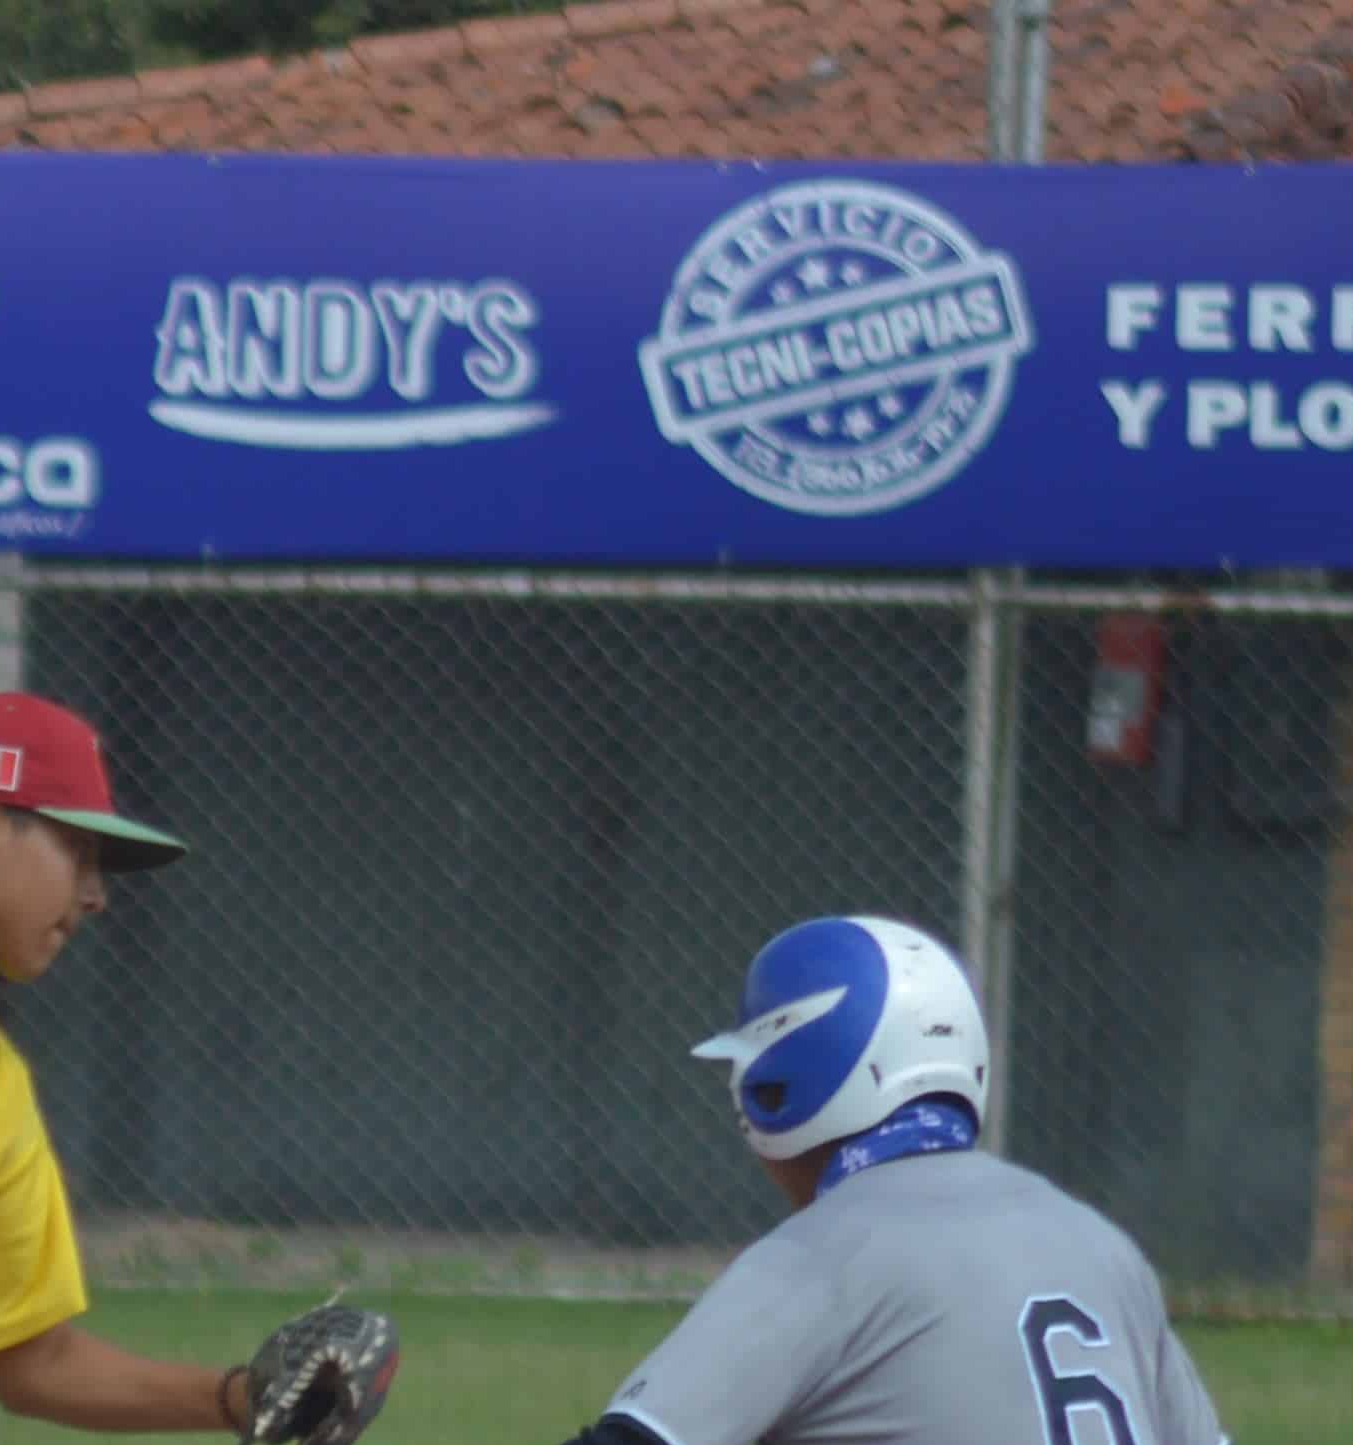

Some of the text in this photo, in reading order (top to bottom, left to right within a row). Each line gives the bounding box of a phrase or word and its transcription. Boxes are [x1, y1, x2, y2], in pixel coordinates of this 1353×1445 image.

[690, 200, 937, 319] SERVICIO
[155, 280, 536, 399] ANDY'S
[673, 286, 1000, 409] TECNI-COPIAS
[1102, 382, 1164, 447] Y
